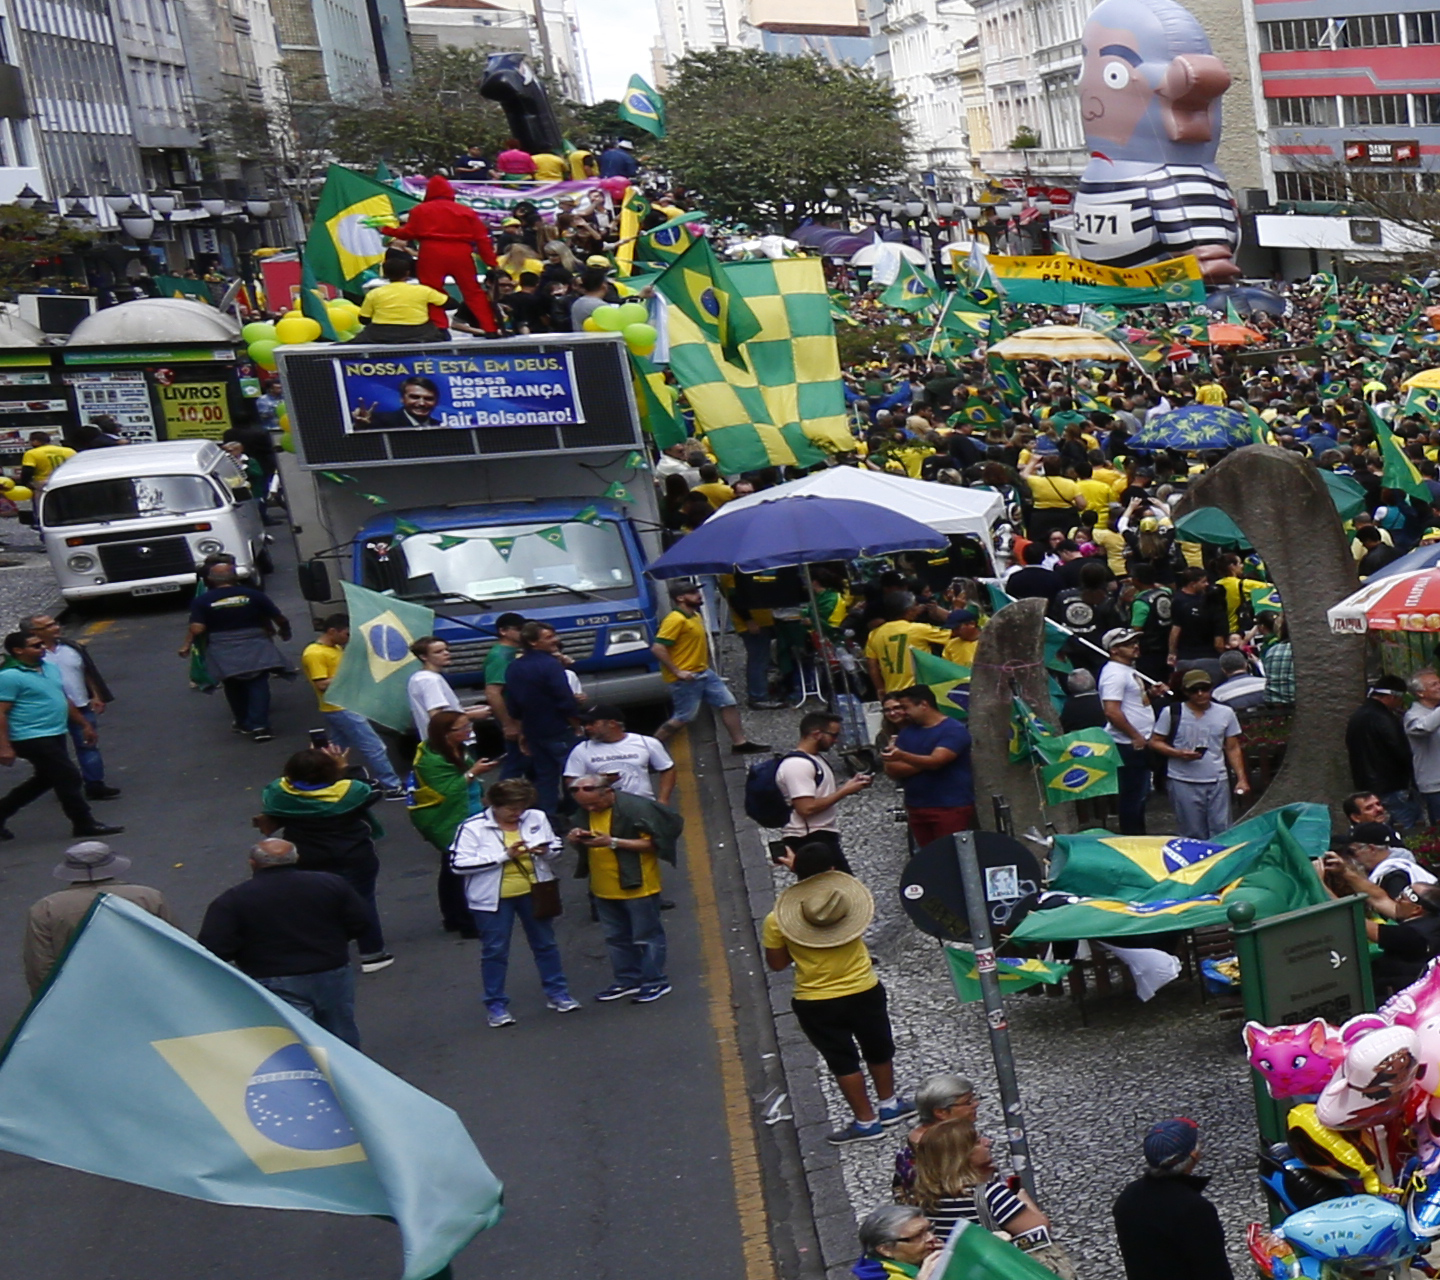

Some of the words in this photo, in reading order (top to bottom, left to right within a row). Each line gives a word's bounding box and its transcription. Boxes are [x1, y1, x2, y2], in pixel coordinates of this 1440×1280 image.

[347, 363, 409, 376] NOSSA
[413, 358, 435, 374] FÉ
[440, 358, 480, 374] ESTÁ
[485, 361, 509, 372] EM
[514, 357, 563, 371] DEUS.
[449, 376, 506, 386] Nossa
[164, 386, 221, 400] LIVROS
[451, 383, 566, 400] ESPERANÇA
[452, 400, 476, 408] em
[439, 412, 472, 427] Jair
[477, 407, 572, 426] Bolsonaro!
